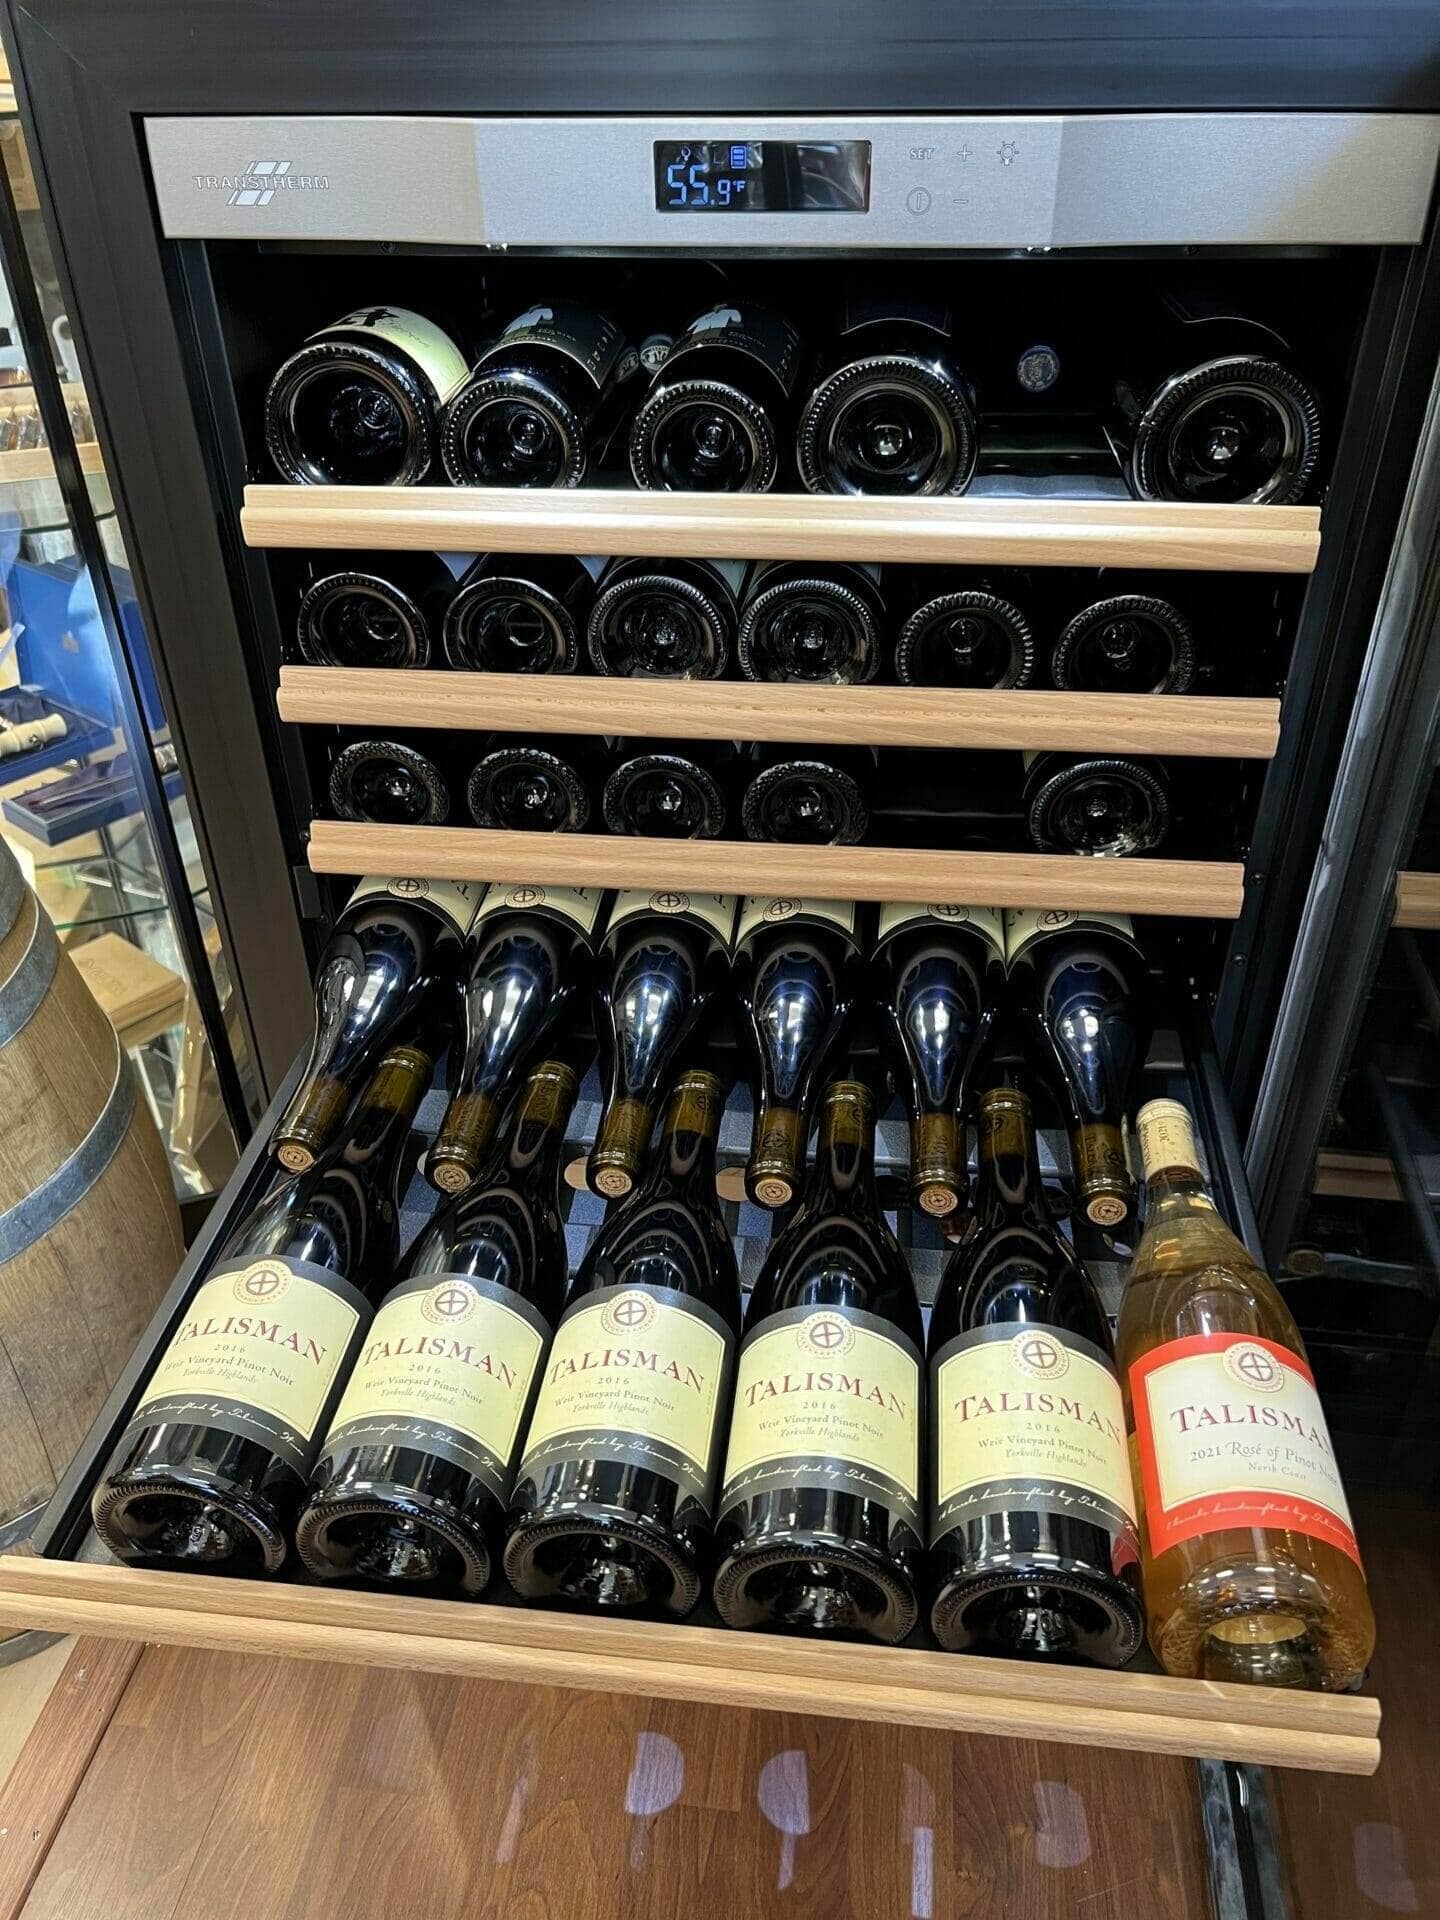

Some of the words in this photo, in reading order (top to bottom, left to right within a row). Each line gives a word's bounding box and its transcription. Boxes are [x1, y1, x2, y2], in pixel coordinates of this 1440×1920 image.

[909, 147, 936, 160] SET
[192, 175, 330, 190] TRANSTHERM
[173, 1317, 327, 1365] TALISMAN
[214, 1344, 246, 1353] 2016
[187, 1355, 233, 1369] Vineyard
[237, 1358, 265, 1373] Pinot
[269, 1367, 295, 1386] Noir
[362, 1336, 518, 1389] TALISMAN
[408, 1363, 441, 1374] 2016
[549, 1348, 705, 1394] TALISMAN
[215, 1369, 259, 1384] Highlands
[597, 1377, 630, 1385] 2016
[388, 1376, 430, 1389] Vineyard
[433, 1379, 459, 1394] Pinot
[462, 1388, 483, 1405] Noir
[416, 1390, 456, 1406] Highlands
[745, 1372, 906, 1420] TALISMAN
[578, 1390, 621, 1403] Vineyard
[624, 1390, 649, 1404] Pinot
[653, 1397, 675, 1411] Noir
[608, 1401, 649, 1415] Highlands
[803, 1401, 836, 1409] 2016
[784, 1415, 829, 1426] Vineyard
[832, 1416, 860, 1429] Pinot
[862, 1423, 884, 1438] Noir
[954, 1392, 1121, 1444] TALISMAN
[818, 1426, 860, 1442] Highlands
[1026, 1422, 1061, 1433] 2016
[1007, 1435, 1054, 1446] Vineyard
[1057, 1439, 1084, 1454] Pinot
[1087, 1448, 1108, 1464] Noir
[1046, 1450, 1087, 1467] Highlands
[1190, 1446, 1222, 1462] 2021
[1226, 1441, 1262, 1457] Rosé
[1267, 1446, 1280, 1464] of
[1285, 1448, 1315, 1470] Pinot
[1248, 1461, 1277, 1473] North
[1281, 1466, 1307, 1481] Coast
